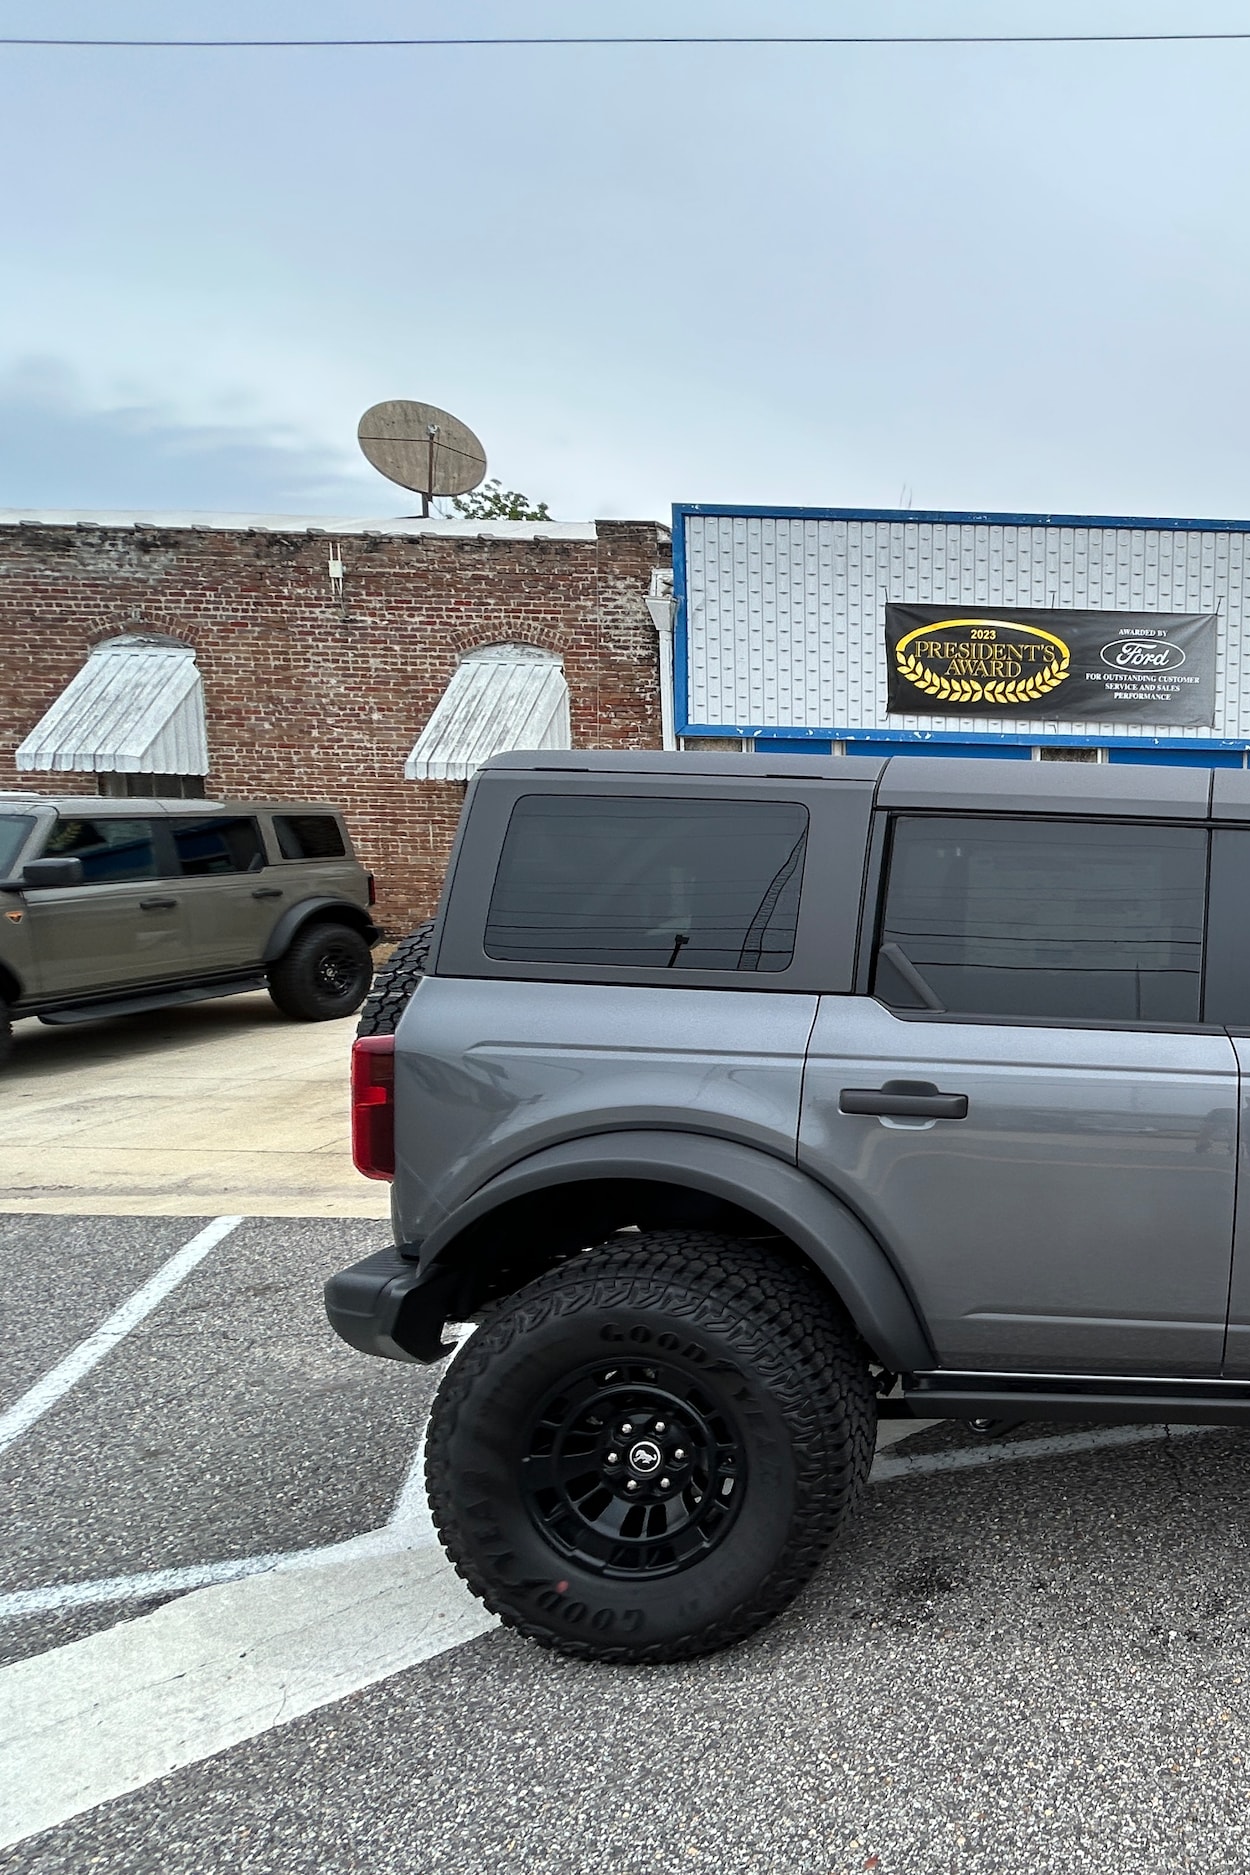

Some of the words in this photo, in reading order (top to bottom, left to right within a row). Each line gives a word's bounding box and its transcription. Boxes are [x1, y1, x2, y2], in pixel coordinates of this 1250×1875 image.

[970, 629, 997, 640] 2023
[1118, 629, 1156, 637] AWARDED
[1157, 629, 1168, 637] BY
[914, 640, 1056, 662] PRESIDENT'S
[1115, 642, 1170, 666] Ford
[944, 659, 1022, 678] AWARD
[1085, 673, 1102, 681] FOR
[1102, 673, 1157, 682] OUTSTANDING
[1158, 676, 1200, 684] CUSTOMER
[1105, 683, 1138, 691] SERVICE
[1156, 684, 1181, 692] SALES
[1113, 692, 1172, 701] PERFORMANCE
